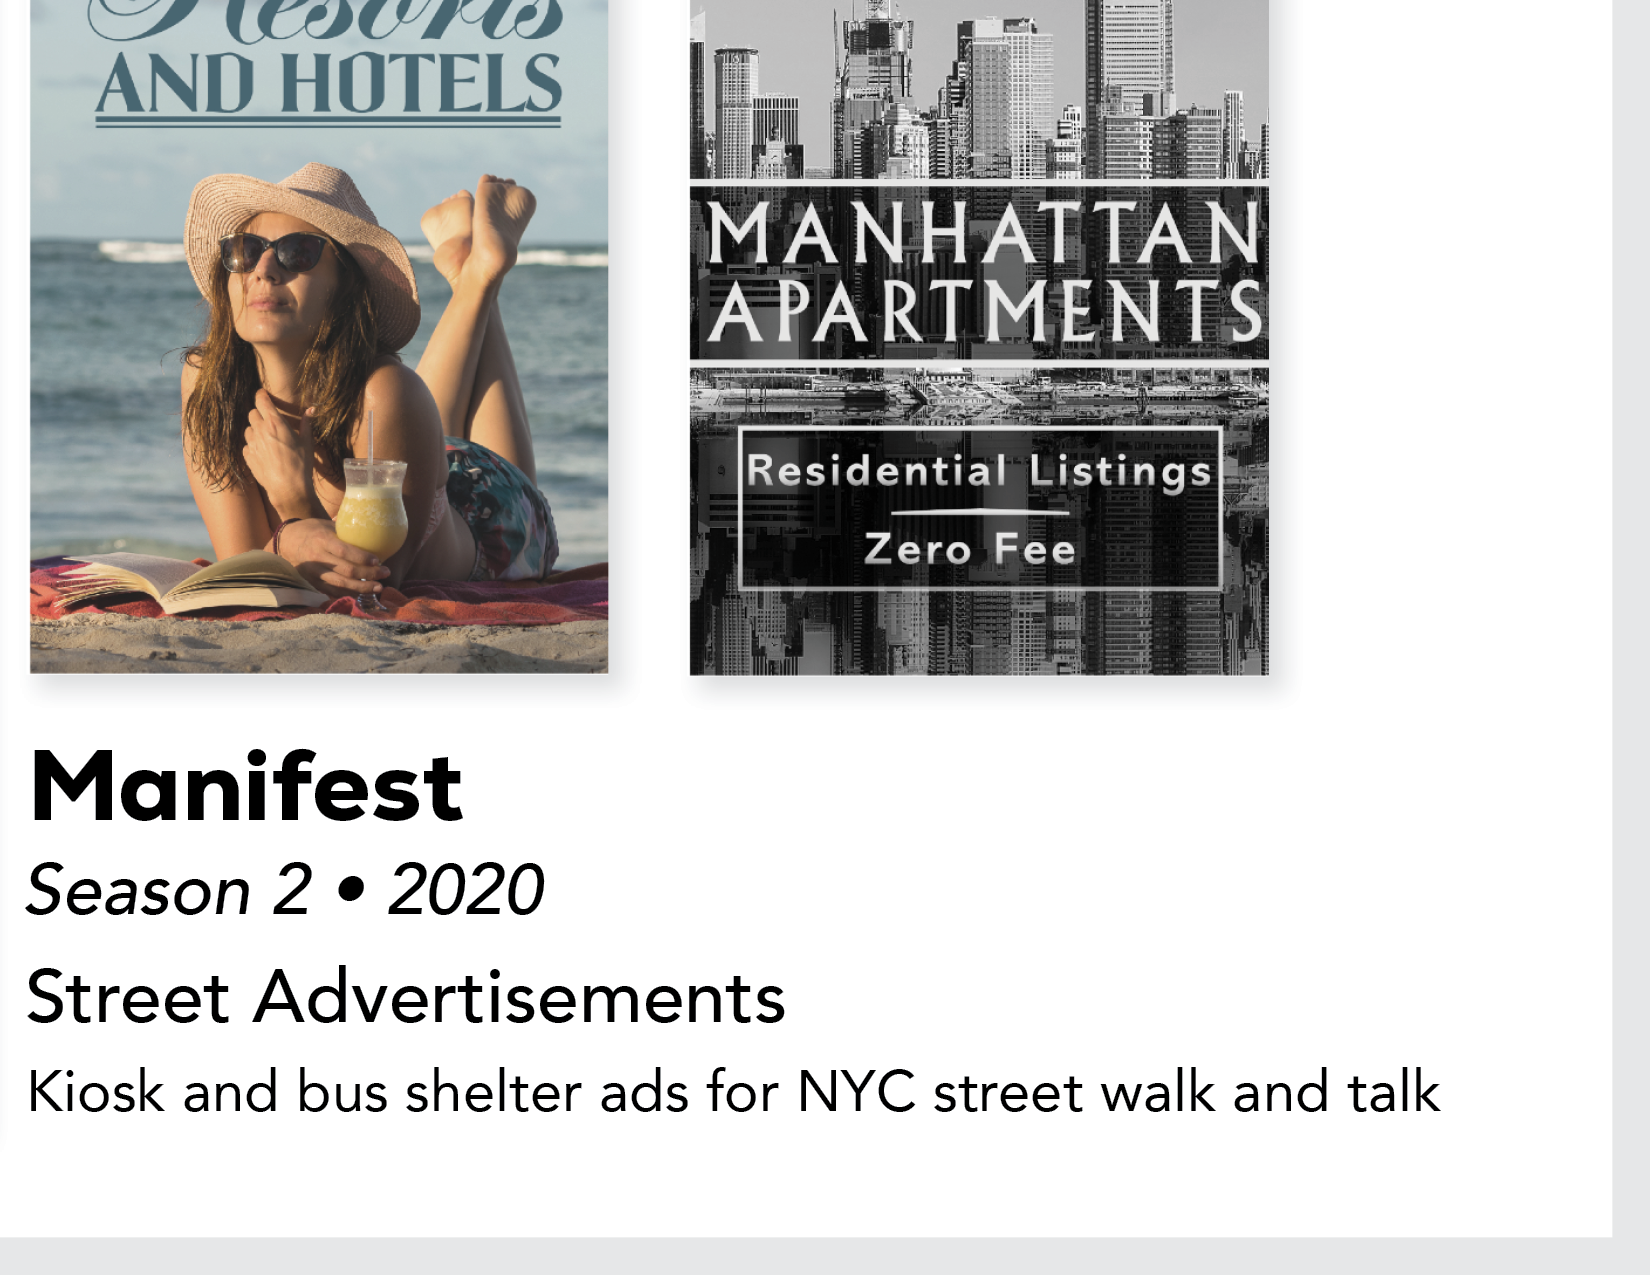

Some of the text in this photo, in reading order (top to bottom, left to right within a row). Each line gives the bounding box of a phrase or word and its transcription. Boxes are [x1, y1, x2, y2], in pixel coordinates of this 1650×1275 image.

[95, 51, 562, 114] AND HOTELS
[707, 200, 1259, 264] MANHATTAN
[706, 278, 1263, 343] APARTMENTS
[747, 452, 1212, 496] Residential Listings
[864, 531, 1076, 566] Zero Fee
